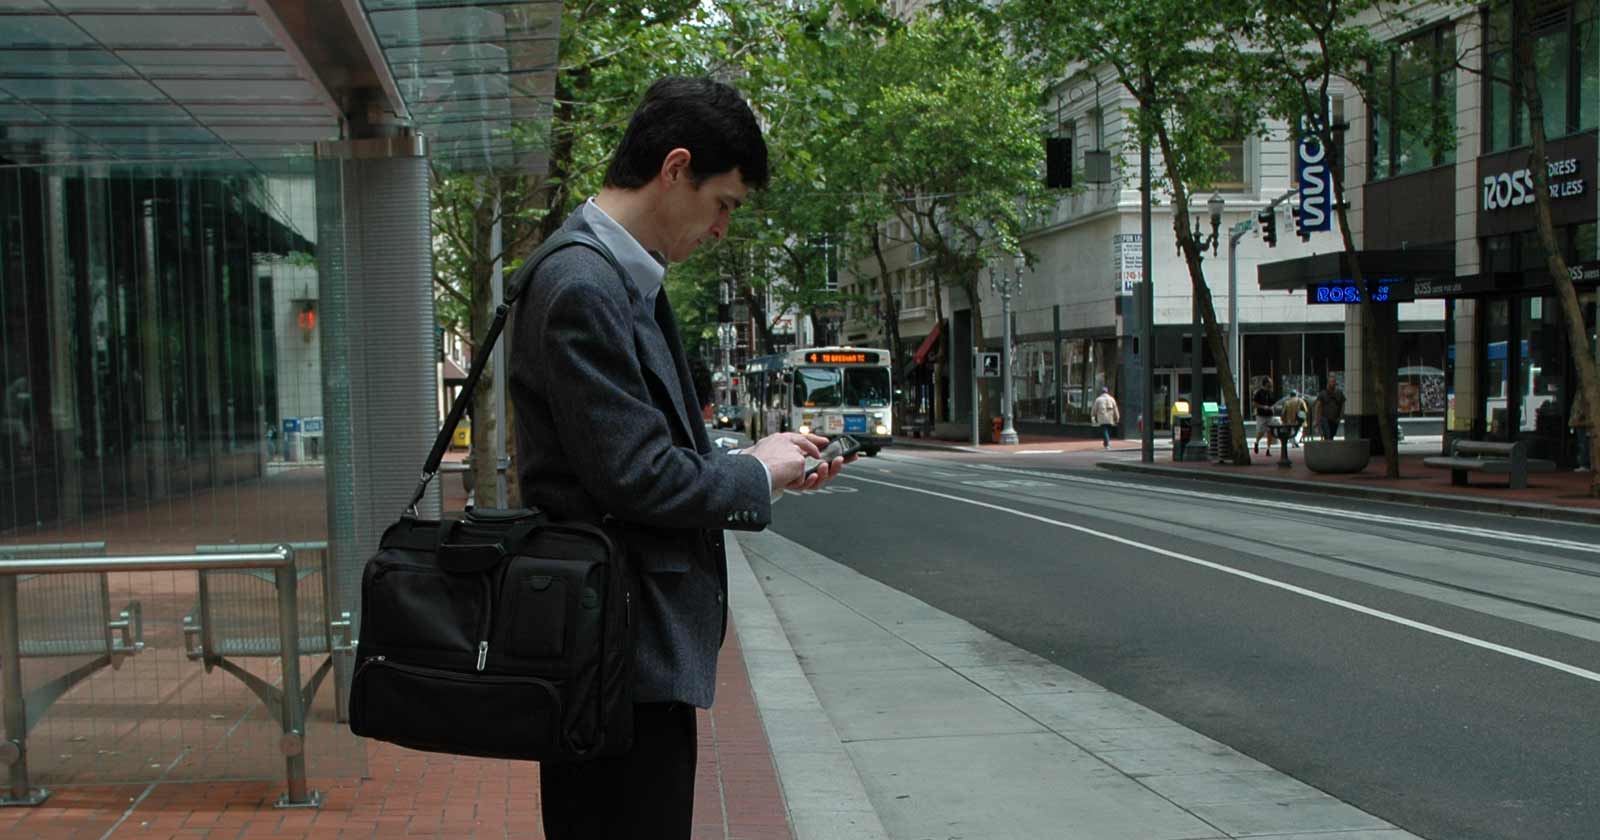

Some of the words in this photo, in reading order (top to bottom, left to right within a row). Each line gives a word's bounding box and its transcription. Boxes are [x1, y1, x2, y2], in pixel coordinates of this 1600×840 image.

[1561, 179, 1583, 197] LESS
[1568, 265, 1584, 280] OSS
[810, 352, 817, 364] 4
